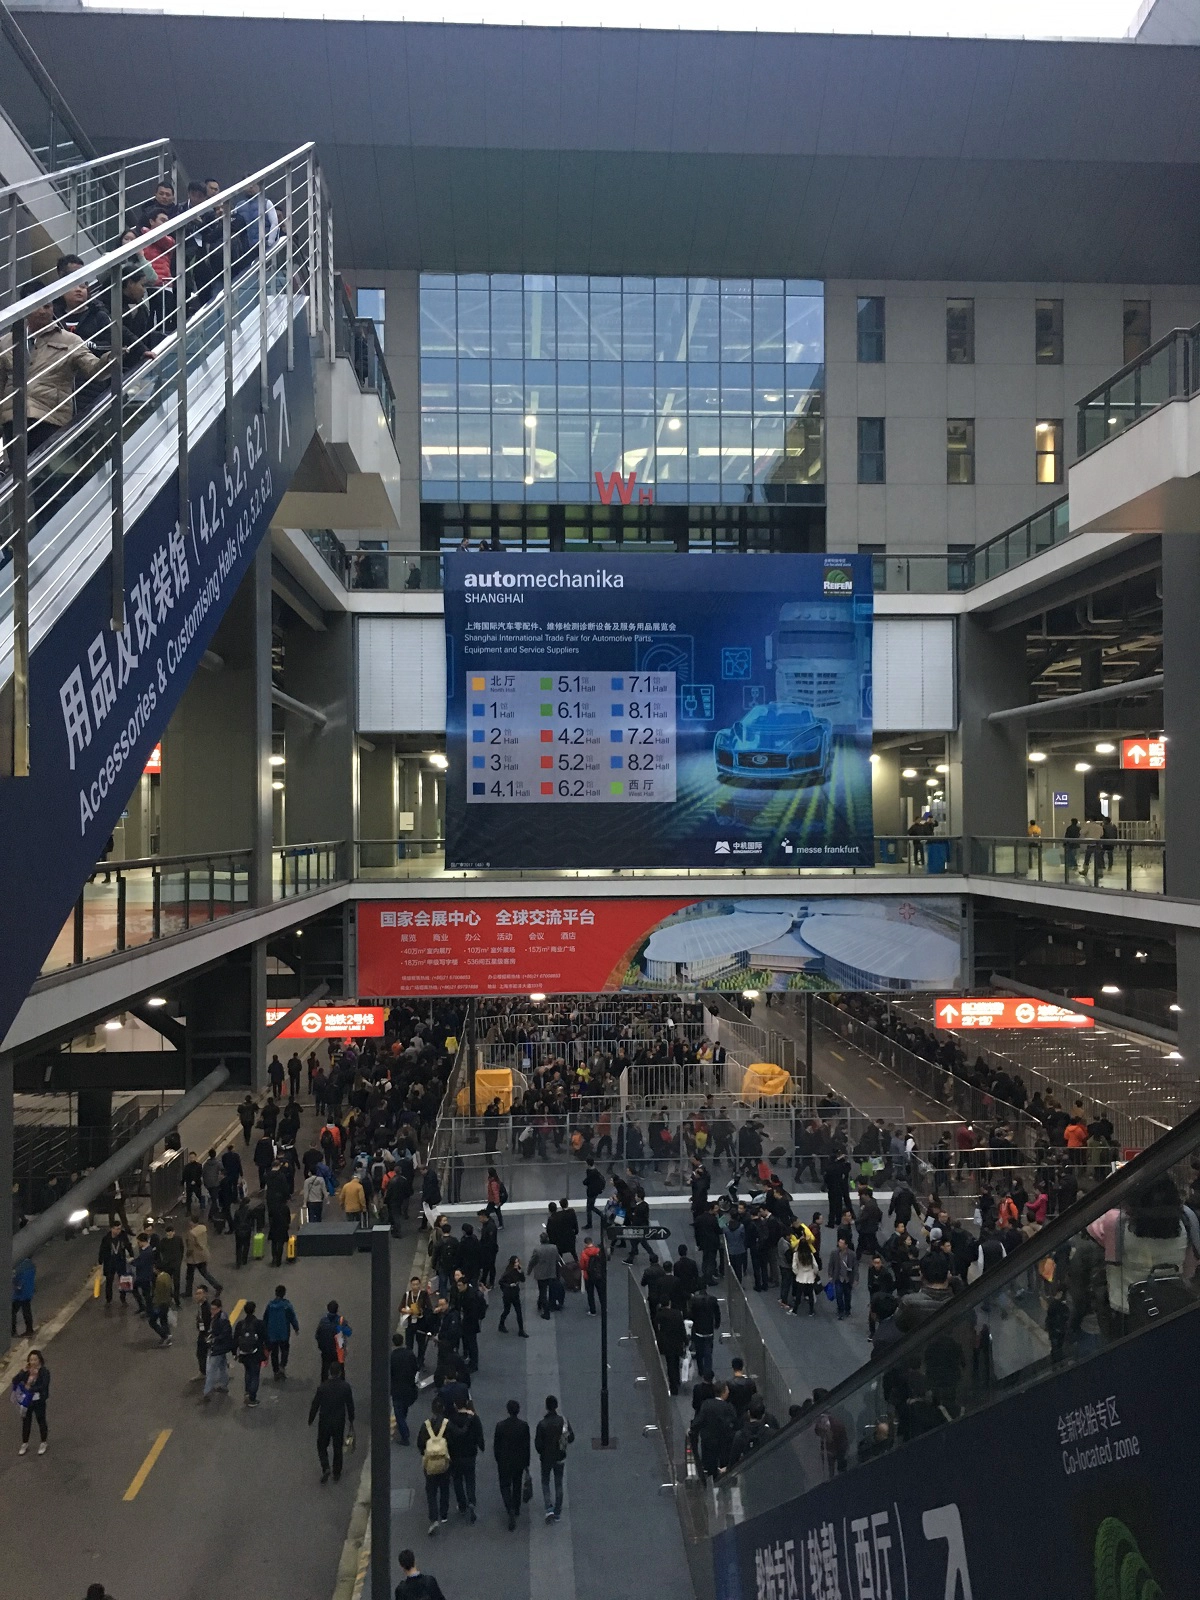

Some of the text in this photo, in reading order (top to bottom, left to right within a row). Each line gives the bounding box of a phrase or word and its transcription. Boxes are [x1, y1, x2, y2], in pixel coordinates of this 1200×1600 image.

[464, 570, 624, 588] automechanika
[824, 581, 852, 590] REIFEN
[464, 592, 524, 604] SHANGHAI
[464, 634, 498, 642] Shanghai
[500, 634, 544, 642] International
[544, 634, 564, 642] Trade
[566, 634, 580, 642] Fair
[580, 634, 590, 642] for
[592, 634, 632, 642] Automotive
[464, 646, 580, 654] Equipment and Service Suppliers
[490, 676, 516, 686] 北厅
[558, 676, 580, 692] 5.1
[628, 676, 650, 692] 7.1
[80, 682, 156, 836] Accessories
[156, 658, 168, 694] &
[166, 568, 221, 674] Customising
[490, 702, 496, 718] 1
[558, 702, 580, 718] 6.1
[628, 702, 650, 718] 8.1
[490, 728, 502, 744] 2
[558, 728, 584, 744] 4.2
[628, 728, 654, 744] 7.2
[490, 754, 502, 772] 3
[558, 754, 584, 770] 5.2
[628, 754, 654, 770] 8.2
[490, 780, 514, 798] 4.1
[558, 780, 584, 796] 6.2
[628, 780, 654, 790] 西厅
[824, 844, 860, 854] frankfurt
[380, 908, 596, 928] 国家会展中心 全球交流平台
[400, 932, 576, 942] 展览 商业 办公 活动 会议 酒店
[325, 1014, 374, 1024] 地铁2号线
[1062, 1436, 1140, 1474] Co-located zone
